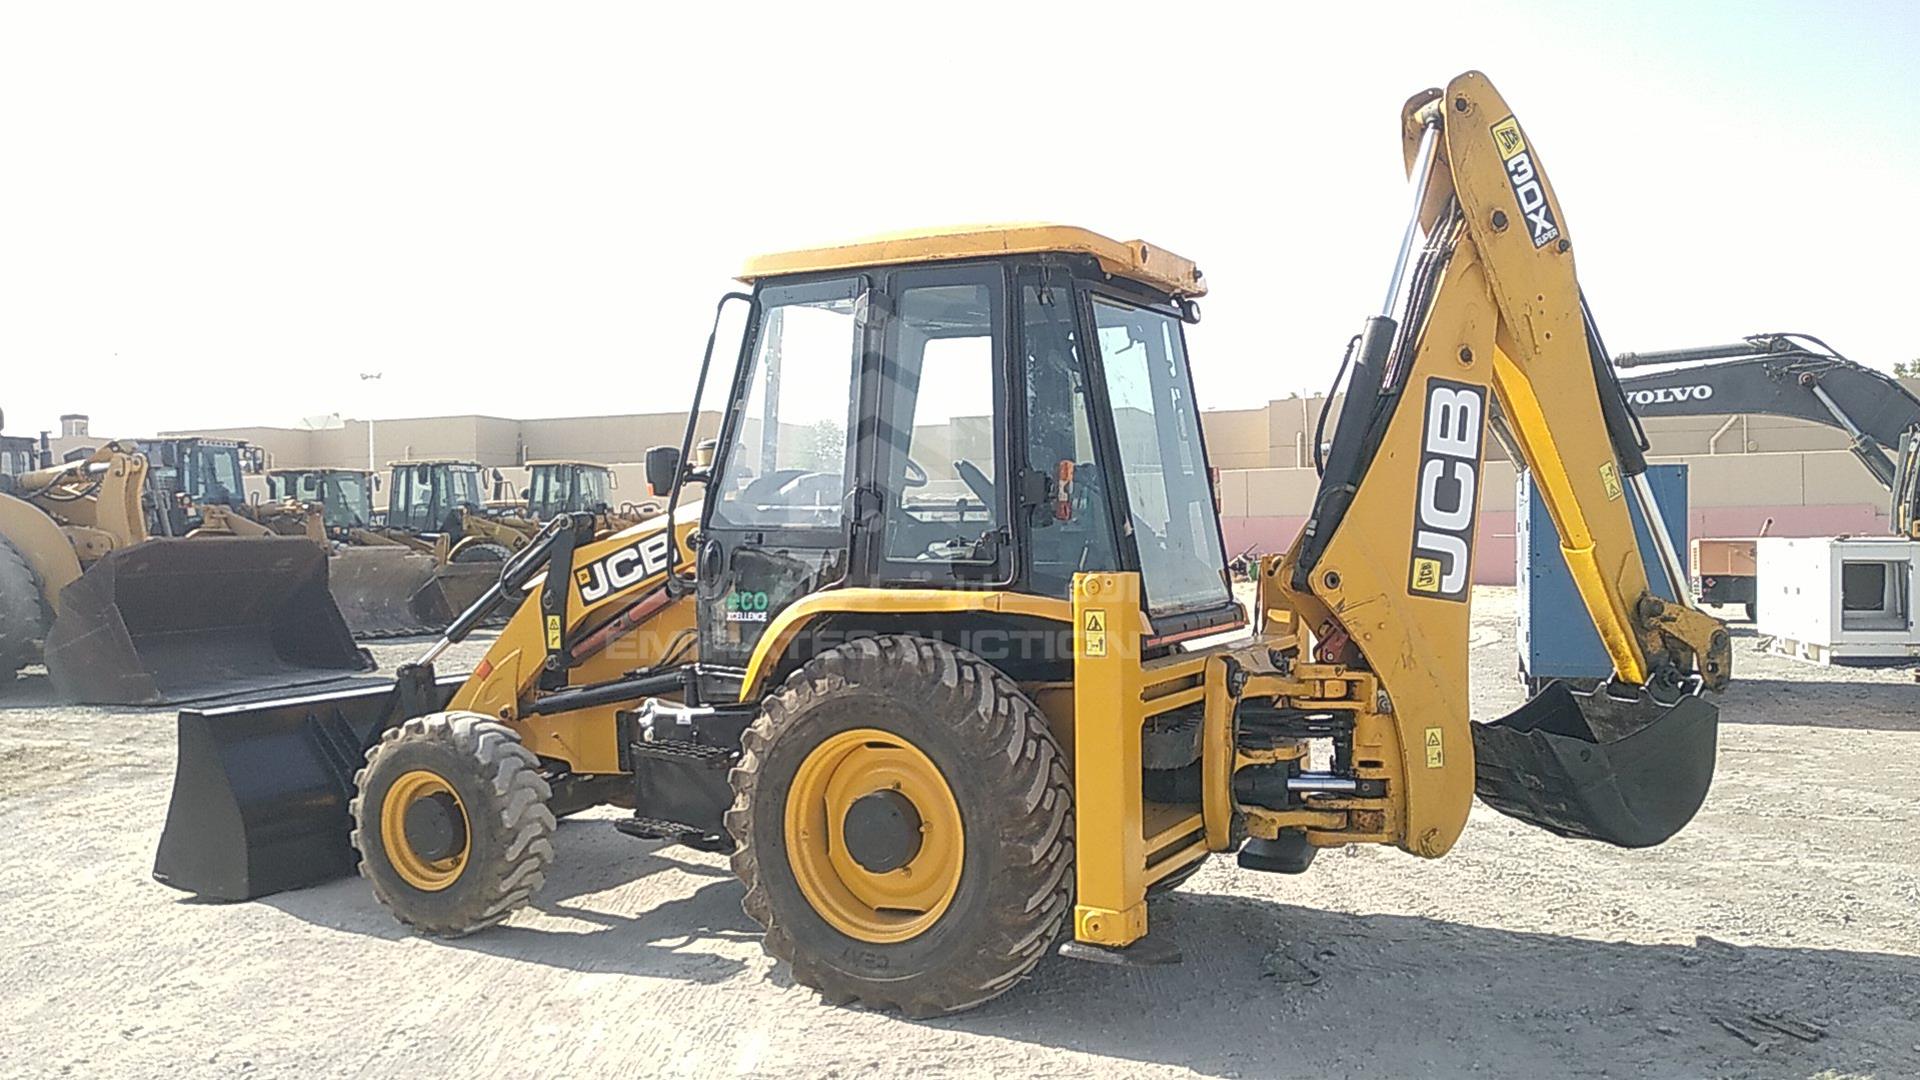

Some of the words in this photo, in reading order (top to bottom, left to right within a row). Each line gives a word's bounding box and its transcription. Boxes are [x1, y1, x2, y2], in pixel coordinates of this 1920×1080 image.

[1500, 128, 1520, 150] JCB
[1507, 152, 1554, 239] 3DX
[1416, 387, 1481, 594] JCB
[582, 532, 678, 601] JCB
[1420, 561, 1433, 585] JCB
